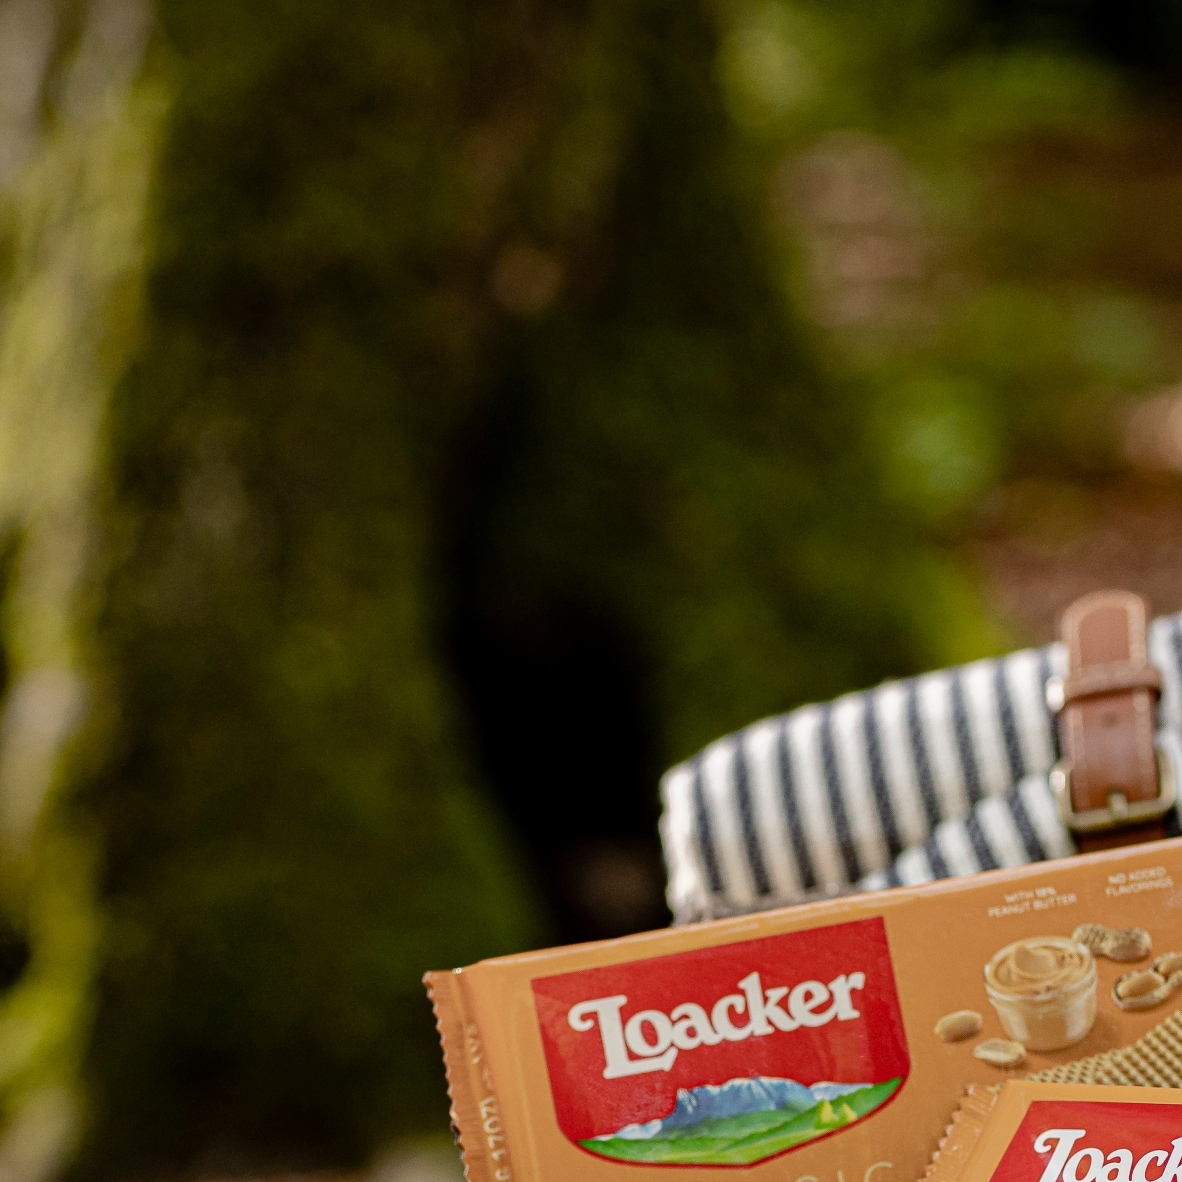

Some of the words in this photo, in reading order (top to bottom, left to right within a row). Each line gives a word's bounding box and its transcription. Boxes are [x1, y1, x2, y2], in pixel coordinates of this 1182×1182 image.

[987, 901, 1030, 918] PEANUT
[1033, 893, 1077, 911] BUTTER
[568, 971, 866, 1079] Loacker
